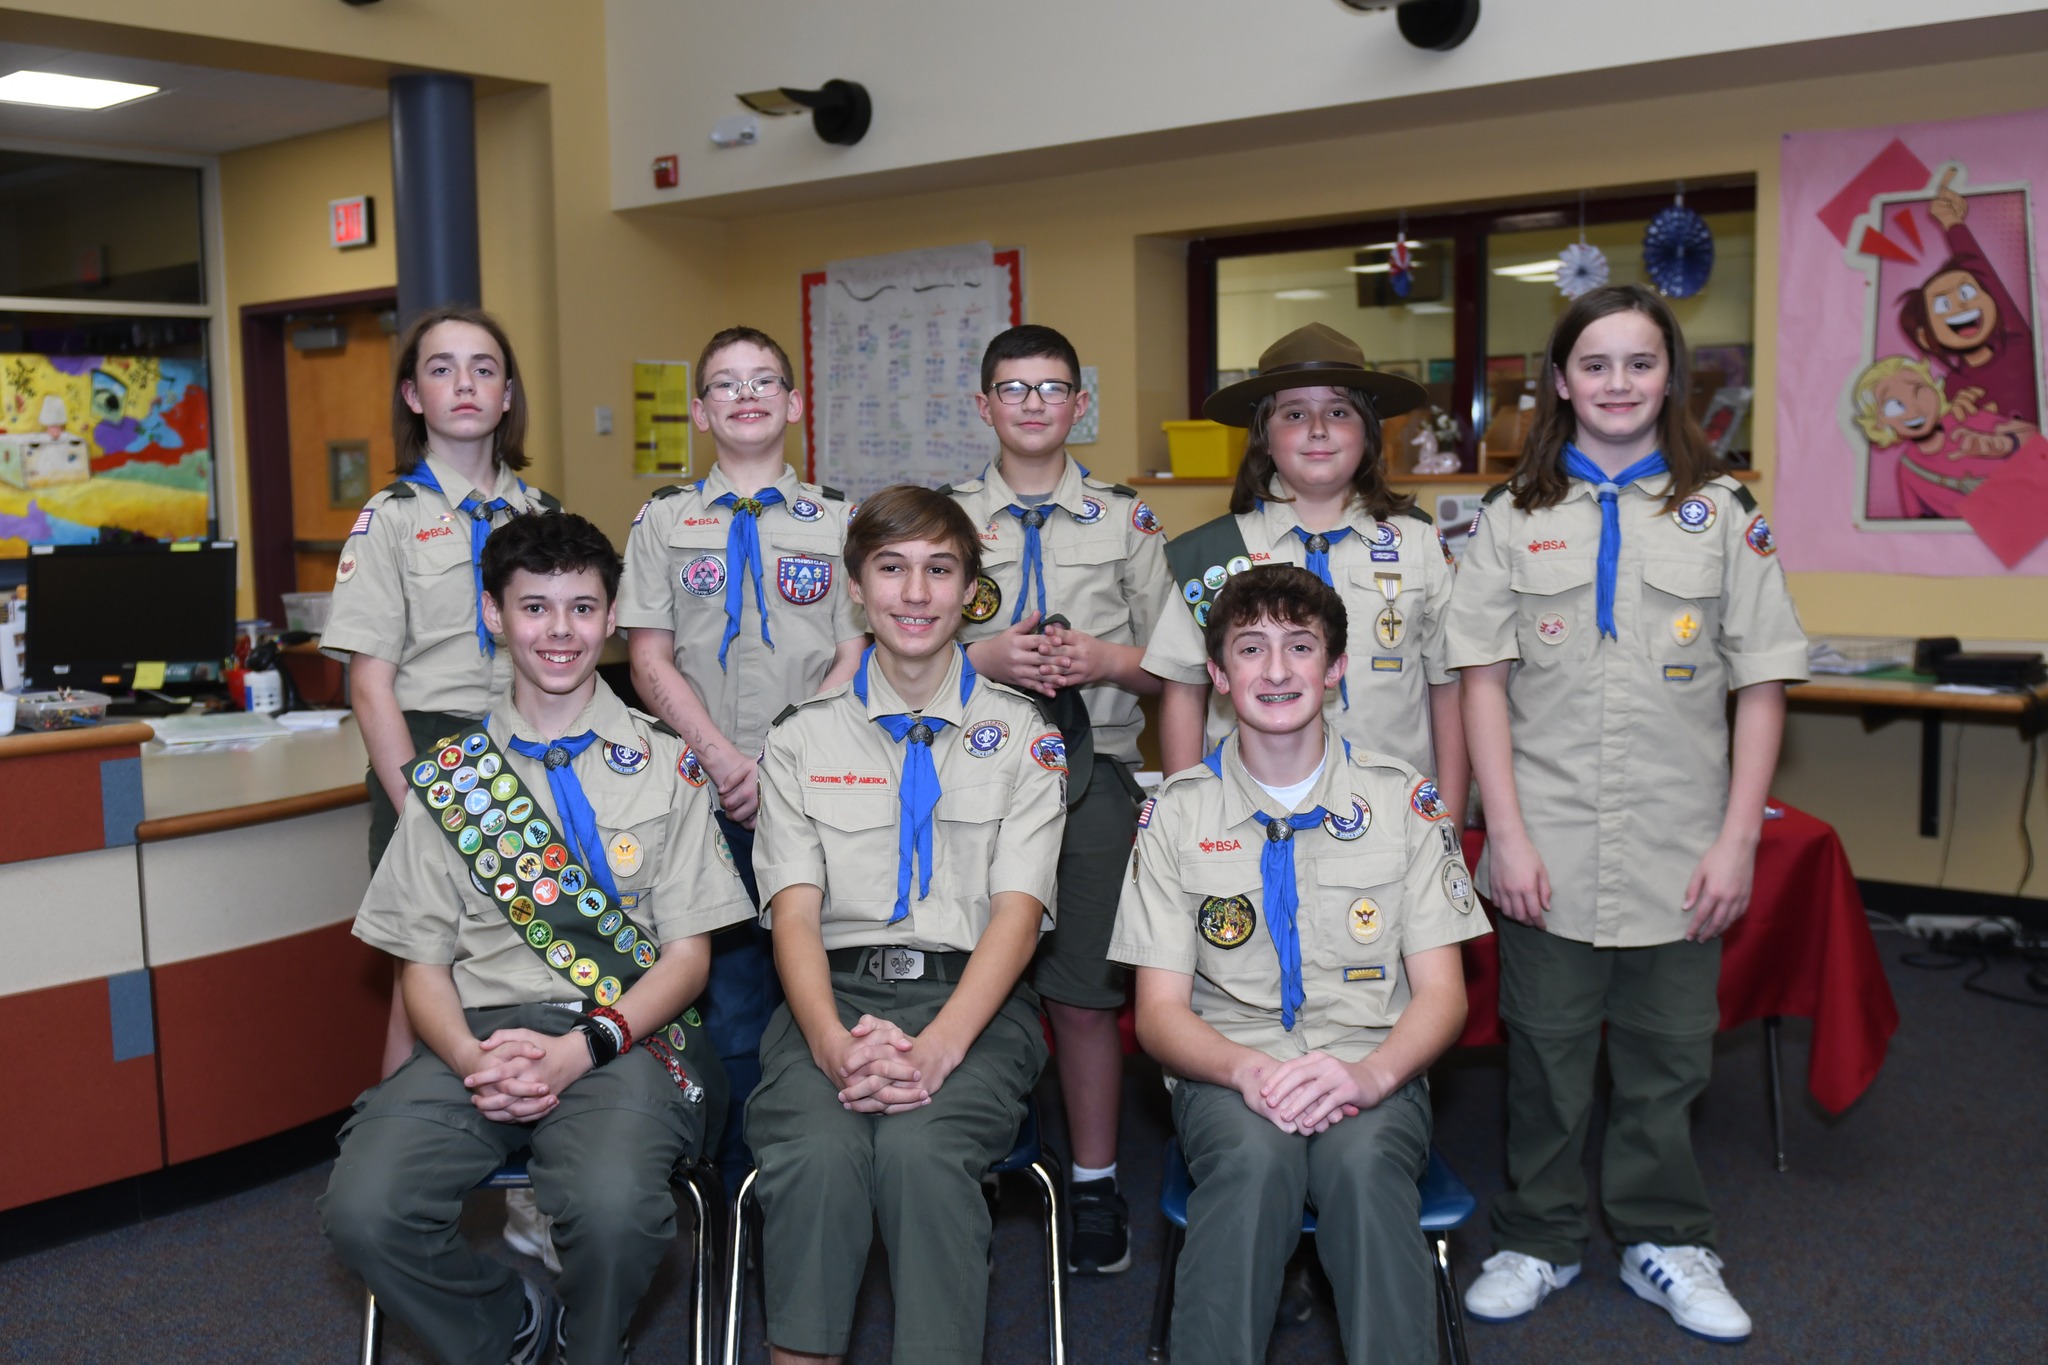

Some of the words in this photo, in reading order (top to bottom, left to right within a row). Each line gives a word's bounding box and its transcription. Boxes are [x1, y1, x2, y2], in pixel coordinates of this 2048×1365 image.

[698, 517, 720, 526] BSA
[430, 526, 454, 538] BSA
[1542, 540, 1567, 551] BSA
[810, 775, 842, 784] SCOUTING
[858, 776, 887, 785] AMERICA
[1216, 839, 1242, 851] BSA
